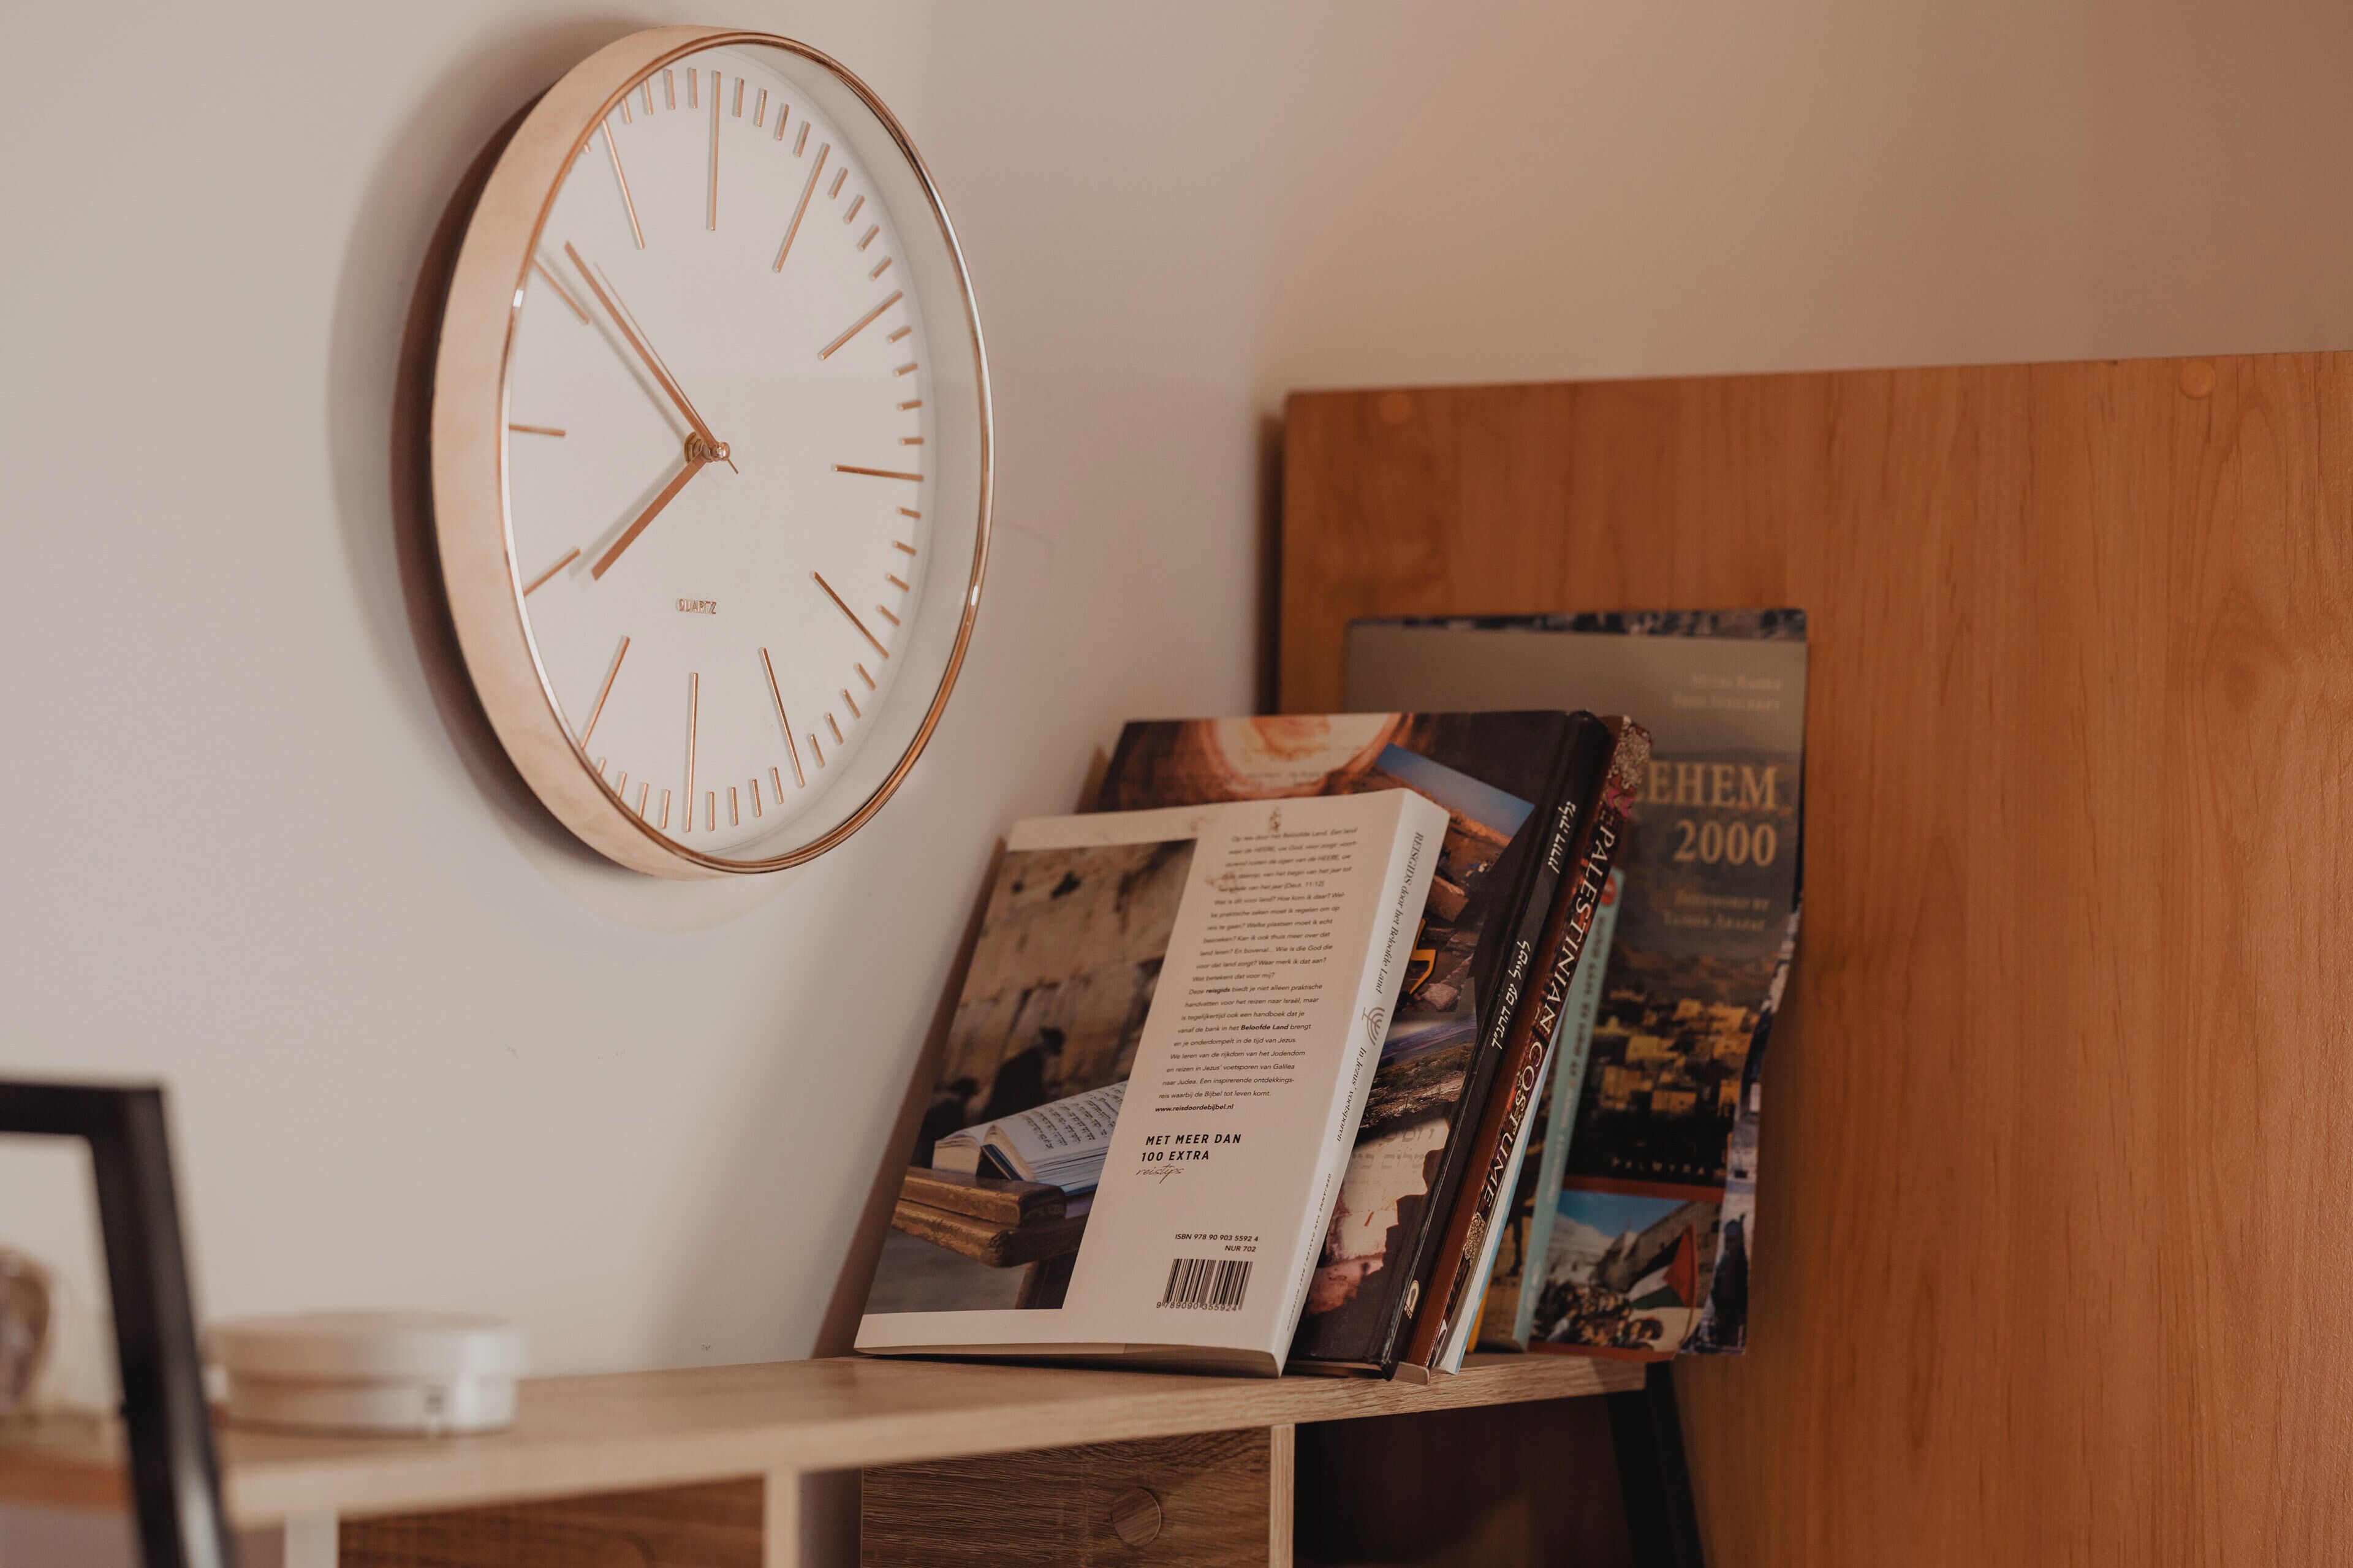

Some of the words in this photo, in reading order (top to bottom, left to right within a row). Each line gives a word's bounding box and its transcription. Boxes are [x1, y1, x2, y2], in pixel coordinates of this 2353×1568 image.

[678, 599, 717, 615] QUARTZ
[1637, 760, 1778, 811] EHEM
[1547, 833, 1566, 874] דורון
[1673, 819, 1776, 867] 2000
[1404, 831, 1425, 885] REISGIDS
[1397, 886, 1409, 907] door
[1393, 909, 1404, 925] het
[1539, 825, 1616, 1034] PALESTINIAN
[1383, 926, 1399, 966] Beloofde
[1508, 940, 1530, 980] לטייל
[1376, 968, 1388, 994] Land
[1506, 983, 1518, 1006] עם
[1188, 1013, 1226, 1021] tegelijkertijd
[1358, 1047, 1367, 1058] In
[1213, 1077, 1252, 1085] inspirerende
[1337, 1090, 1354, 1142] voetsporen
[1483, 1041, 1544, 1208] COSTUME
[1145, 1136, 1170, 1145] MET
[1175, 1135, 1209, 1145] MEER
[1214, 1134, 1241, 1143] DAN
[1142, 1152, 1164, 1162] 100
[1169, 1151, 1208, 1161] EXTRA
[1136, 1163, 1184, 1184] reistips
[1319, 1173, 1332, 1213] GERJANNE
